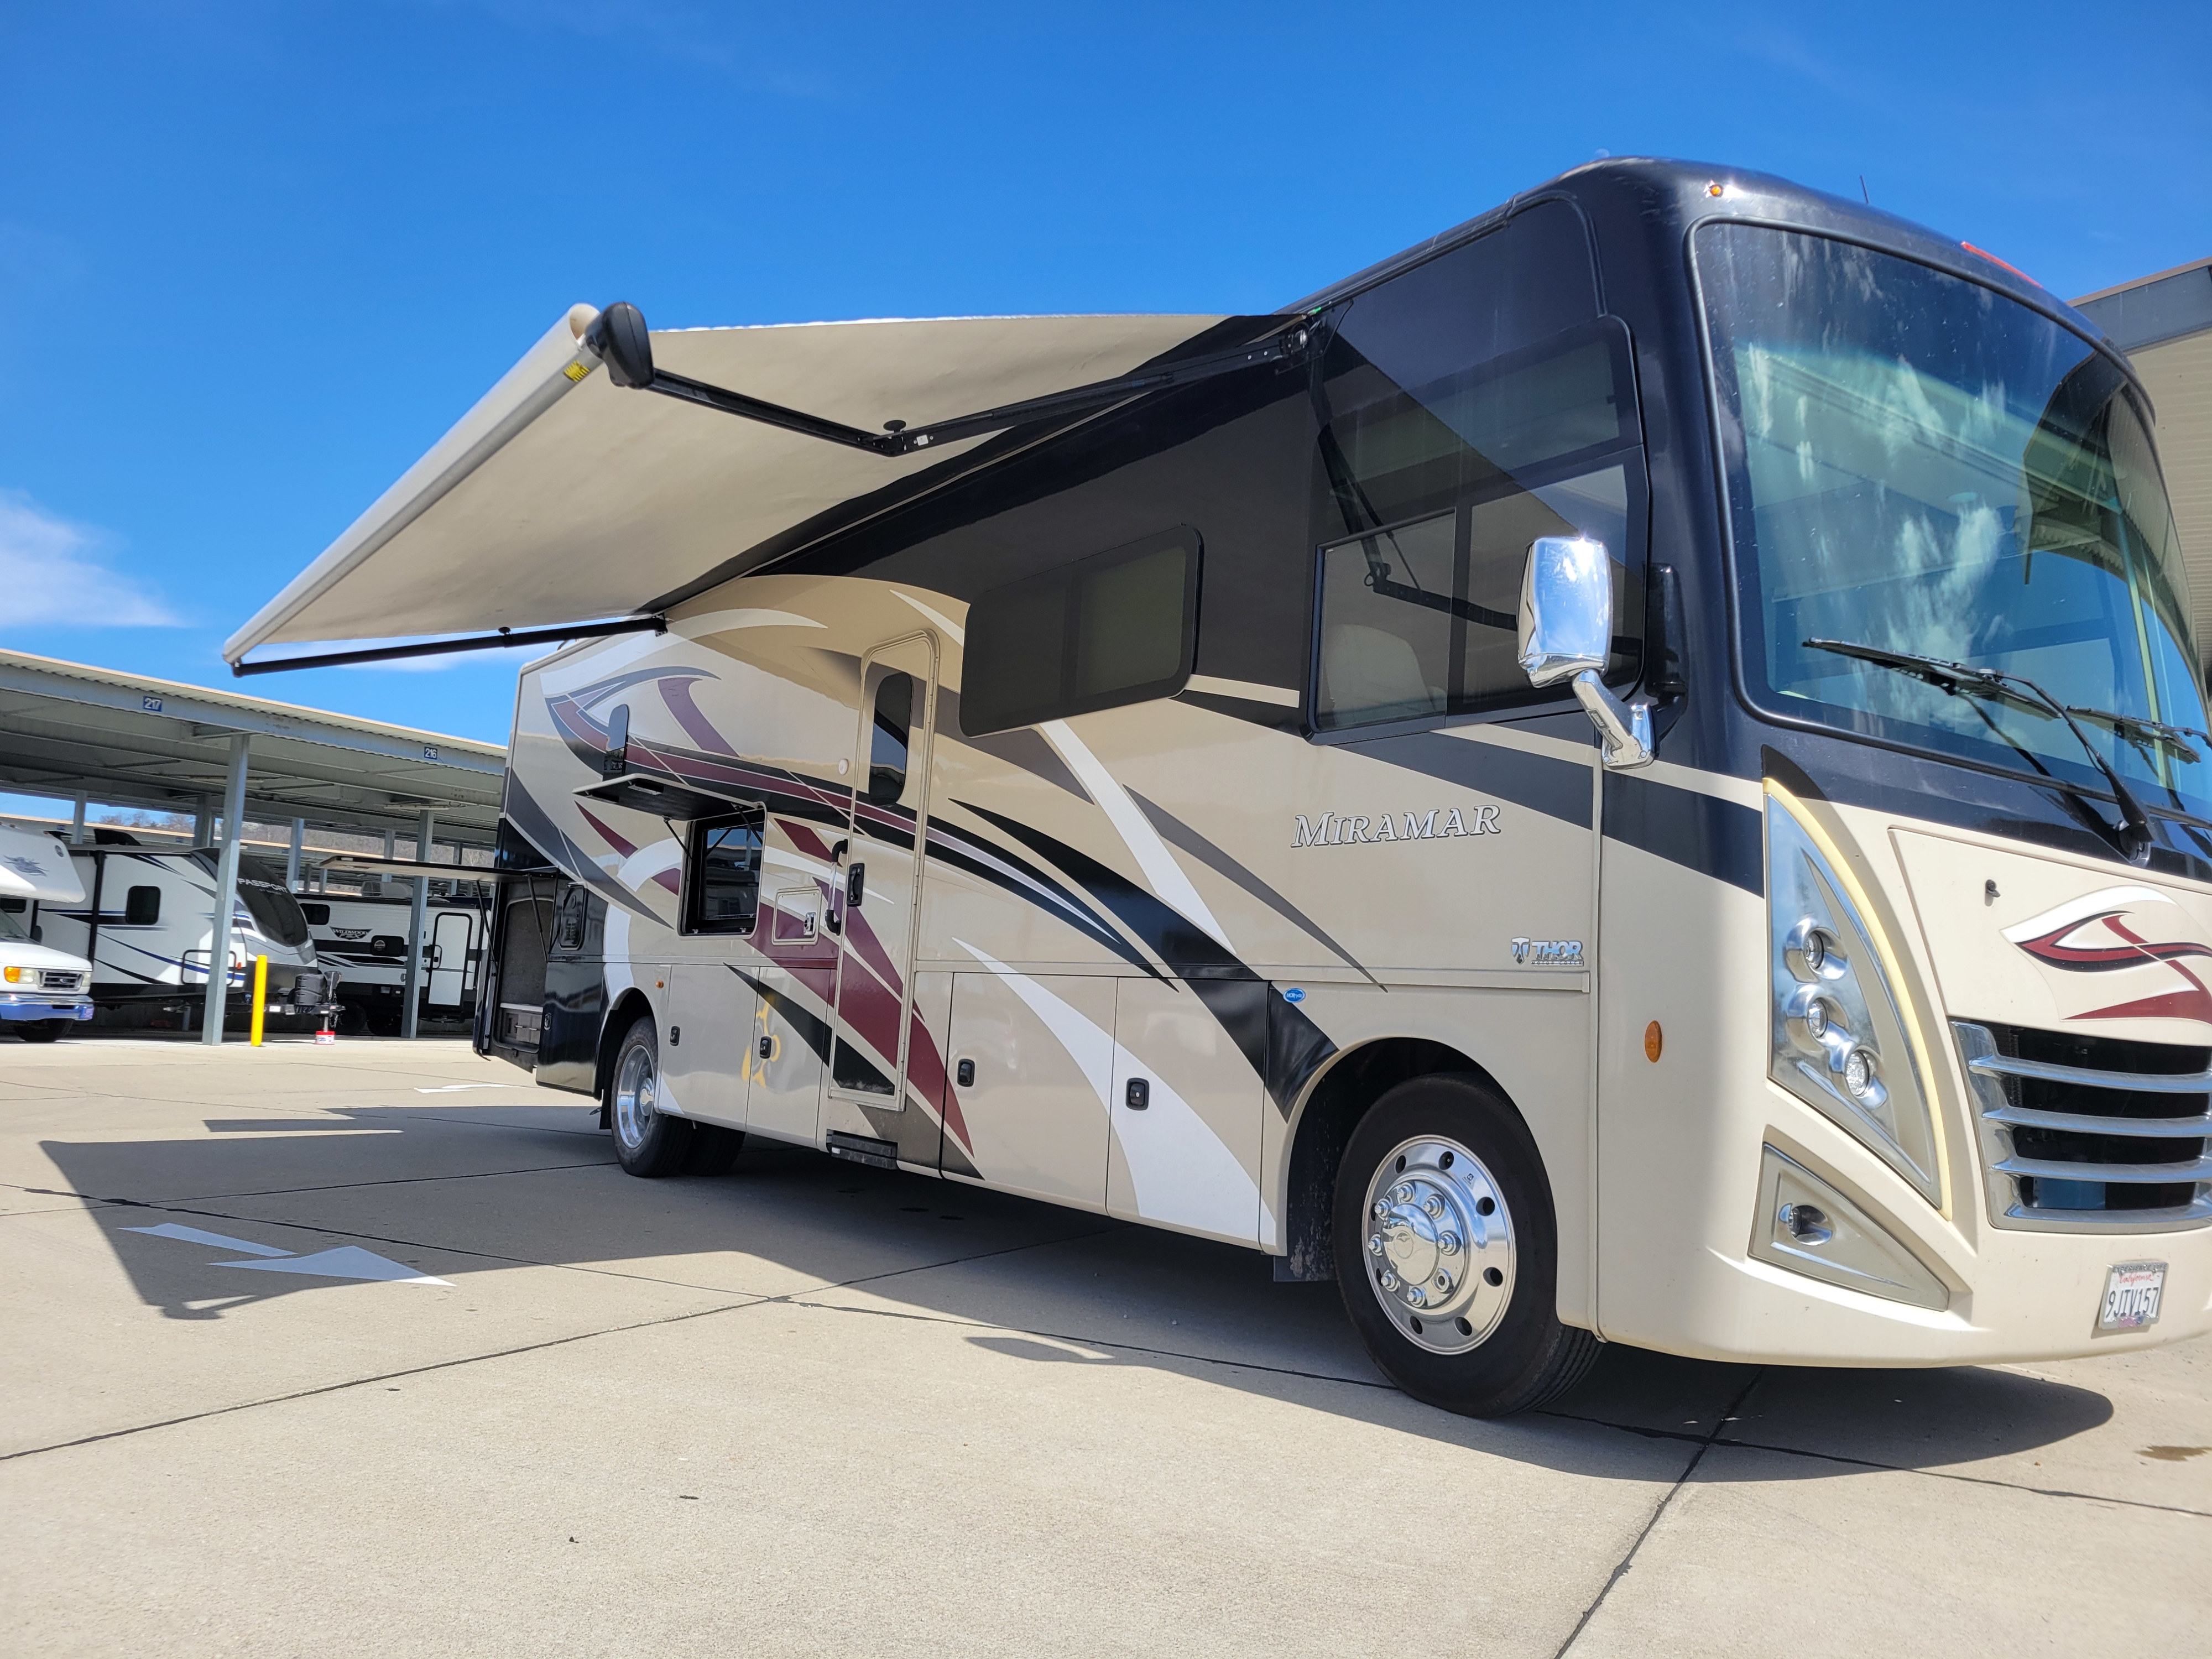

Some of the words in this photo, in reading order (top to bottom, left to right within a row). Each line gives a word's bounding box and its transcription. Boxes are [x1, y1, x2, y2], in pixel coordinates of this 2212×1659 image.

[144, 697, 161, 709] 217
[425, 748, 437, 758] 216
[1290, 805, 1501, 848] MIRAMAR
[237, 878, 288, 893] PASSPORT
[1531, 941, 1583, 960] THOR
[2119, 1272, 2154, 1286] California
